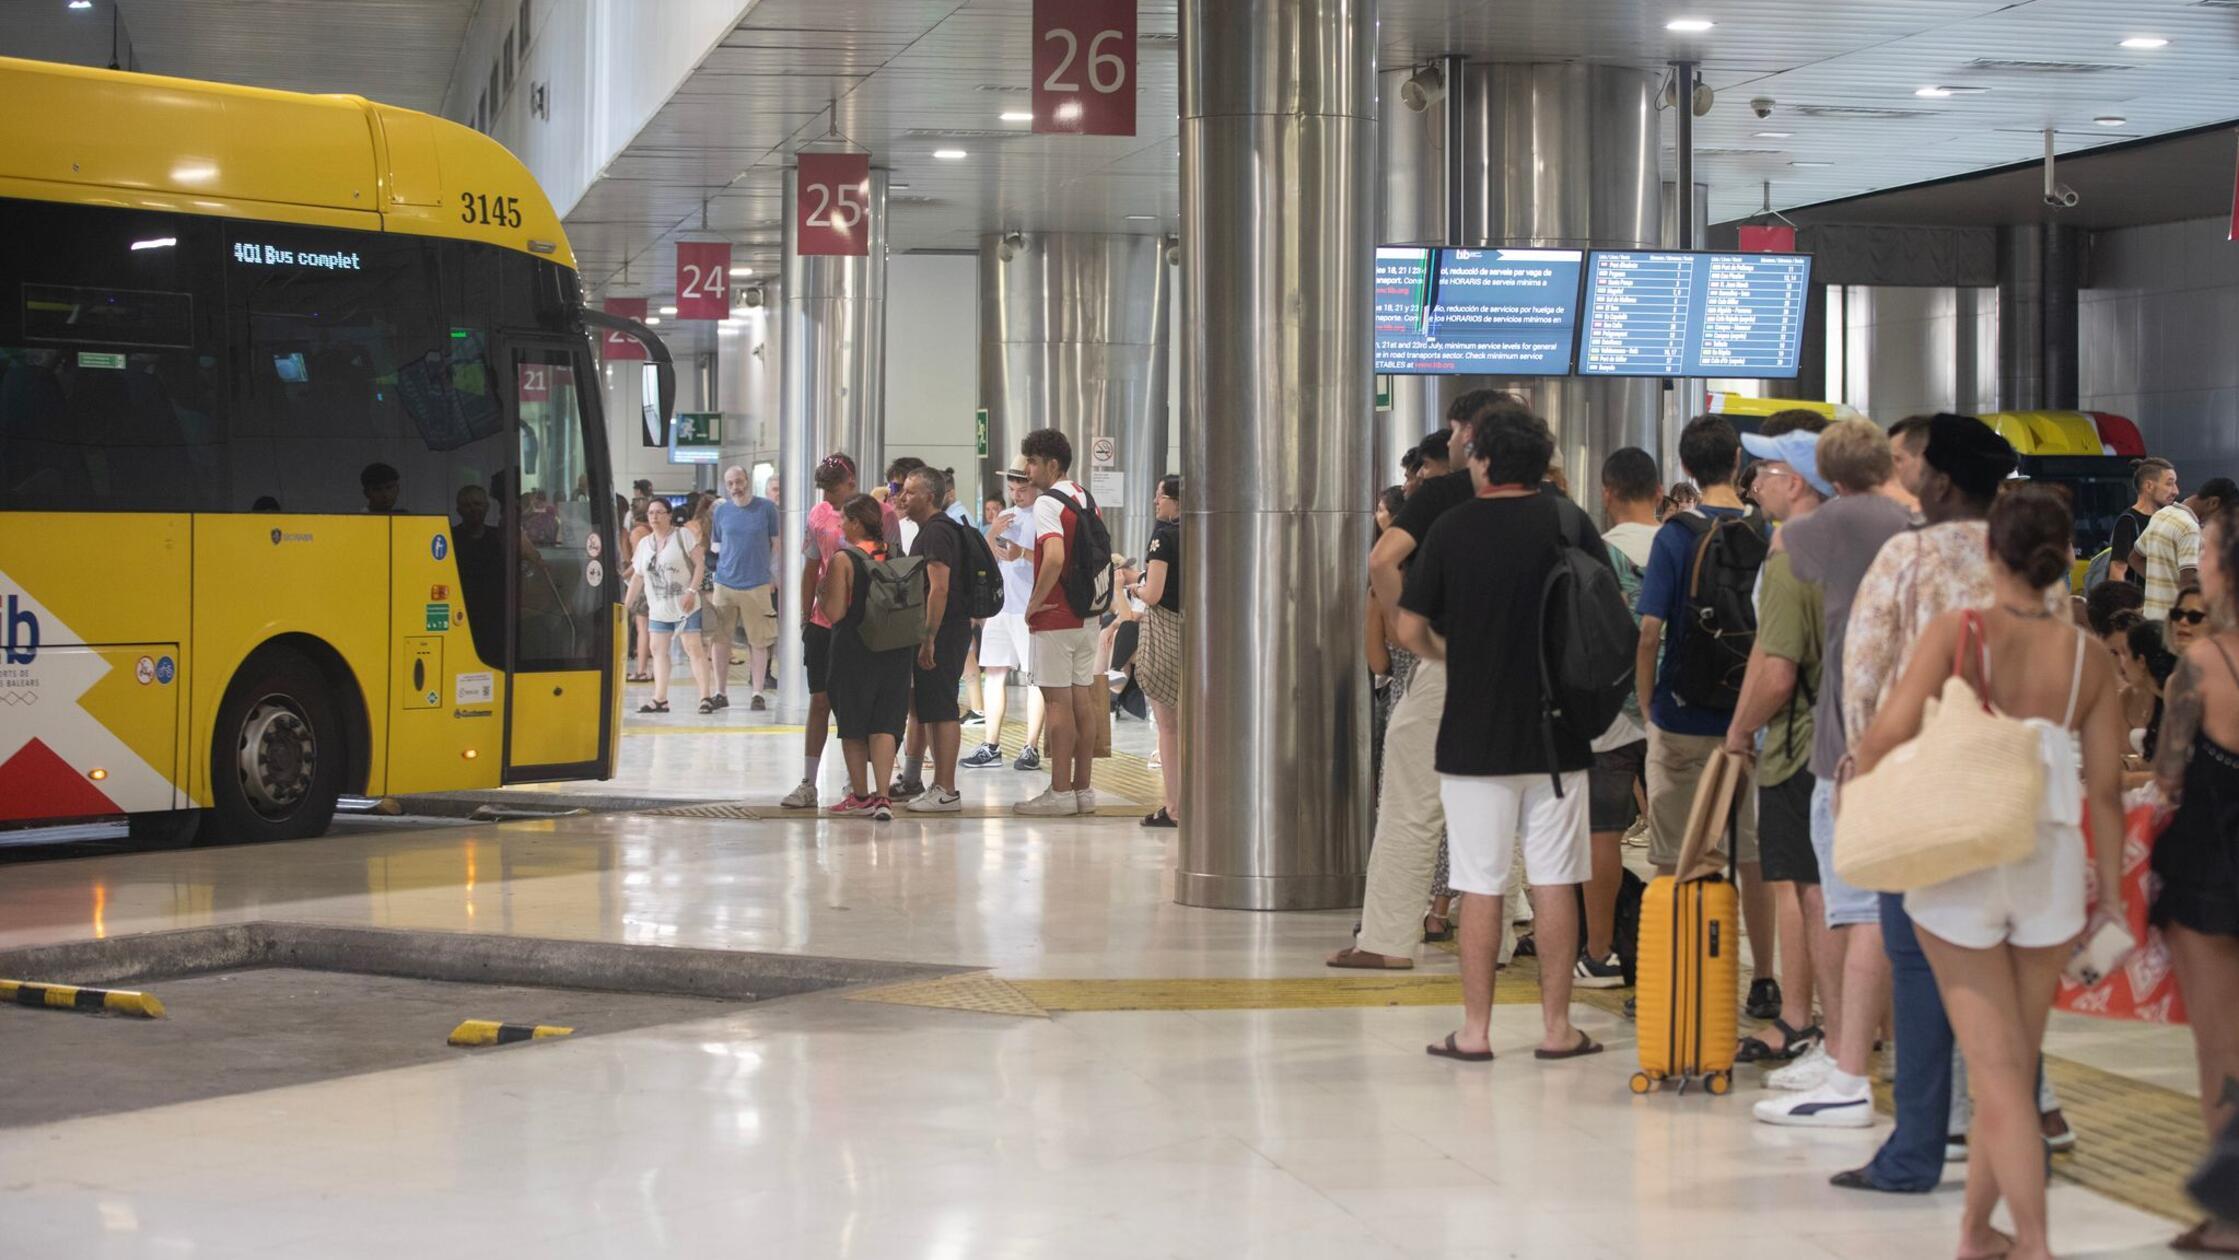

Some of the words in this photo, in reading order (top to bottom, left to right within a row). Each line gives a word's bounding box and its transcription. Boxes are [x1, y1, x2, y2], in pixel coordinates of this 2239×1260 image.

[1043, 28, 1125, 93] 26
[461, 192, 521, 227] 3145
[806, 184, 861, 227] 25
[234, 243, 262, 263] 401
[265, 245, 293, 264] Bus
[297, 252, 360, 269] complet
[1480, 268, 1488, 276] de
[1543, 269, 1552, 277] de
[682, 265, 725, 298] 24
[1450, 278, 1481, 286] HORARIS
[1482, 278, 1491, 286] de
[1446, 303, 1479, 312] reducción
[1480, 304, 1489, 312] de
[1490, 304, 1518, 313] servicios
[1520, 306, 1531, 314] por
[1532, 305, 1554, 314] huelga
[1556, 306, 1564, 314] de
[1446, 314, 1482, 323] HORARIOS
[1483, 315, 1492, 323] de
[1493, 315, 1521, 323] servicios
[1382, 341, 1396, 349] 21st
[1398, 341, 1411, 349] and
[1412, 341, 1428, 349] 23rd
[1428, 341, 1444, 351] July,
[1445, 341, 1476, 350] minimum
[1478, 341, 1500, 350] service
[1502, 342, 1520, 350] levels
[1522, 342, 1531, 351] for
[1533, 343, 1557, 352] general
[1390, 351, 1404, 359] road
[1406, 351, 1440, 360] transports
[1465, 352, 1485, 360] Check
[1487, 352, 1518, 360] minimum
[1520, 352, 1543, 361] service
[1406, 361, 1414, 369] at
[523, 371, 546, 390] 21
[20, 669, 29, 678] DE
[7, 679, 40, 688] BALEARS
